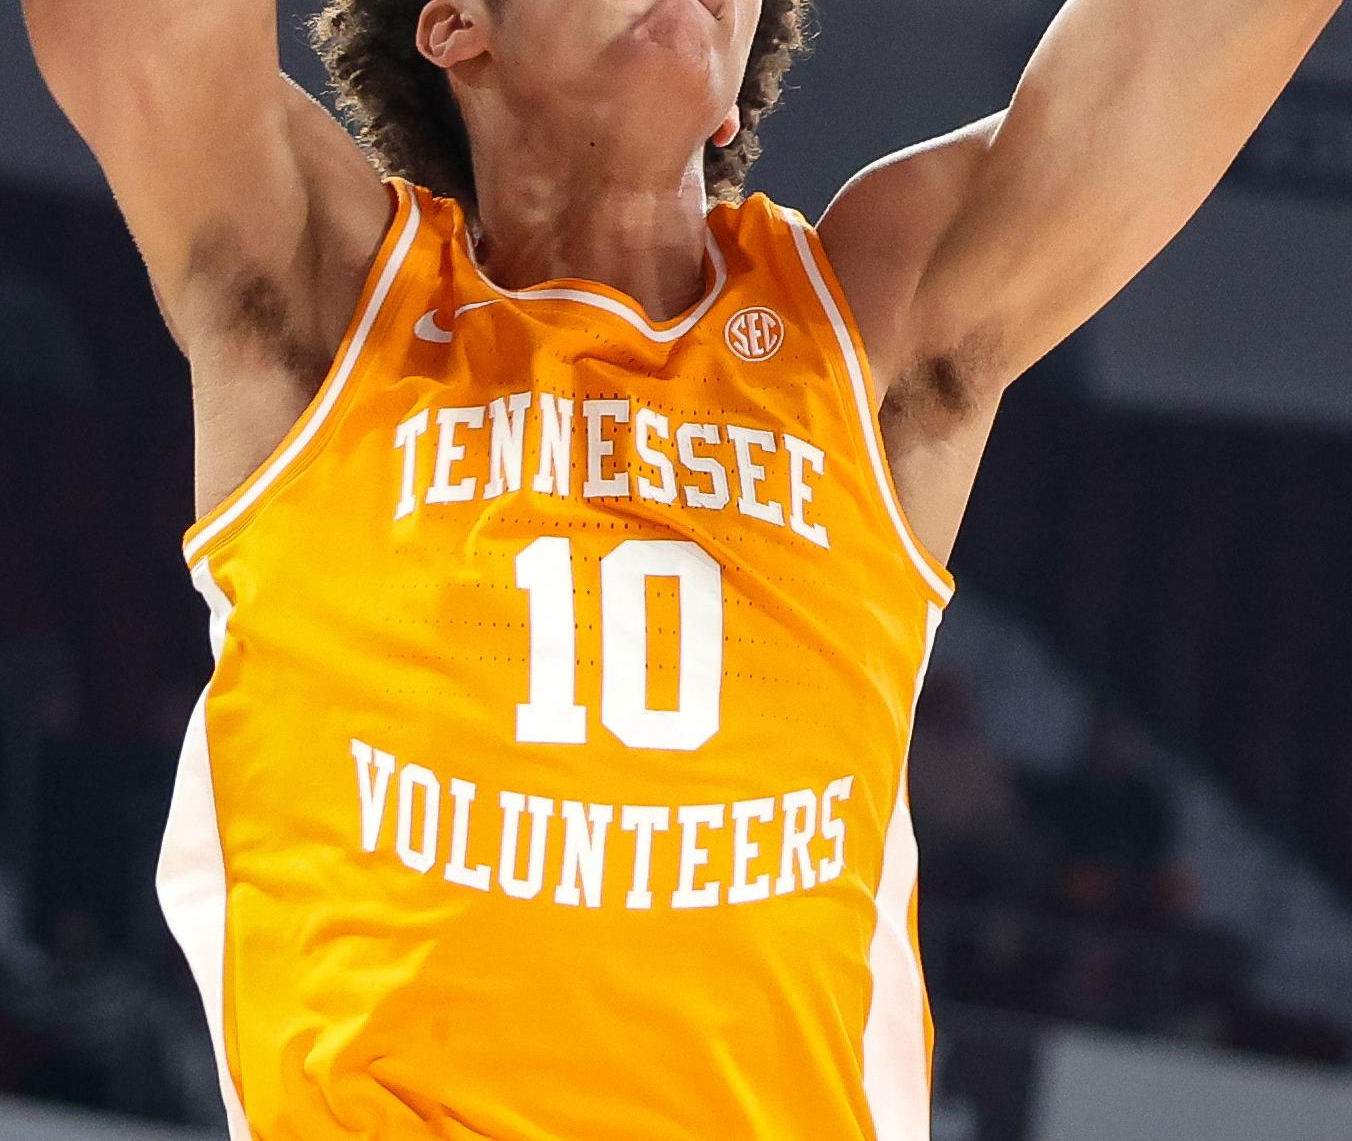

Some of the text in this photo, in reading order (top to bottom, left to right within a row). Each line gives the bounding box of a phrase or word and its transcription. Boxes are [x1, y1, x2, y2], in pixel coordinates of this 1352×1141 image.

[730, 312, 778, 356] SEC
[394, 390, 831, 550] TENNESSEE
[514, 536, 724, 751] 10
[350, 738, 854, 910] VOLUNTEERS
